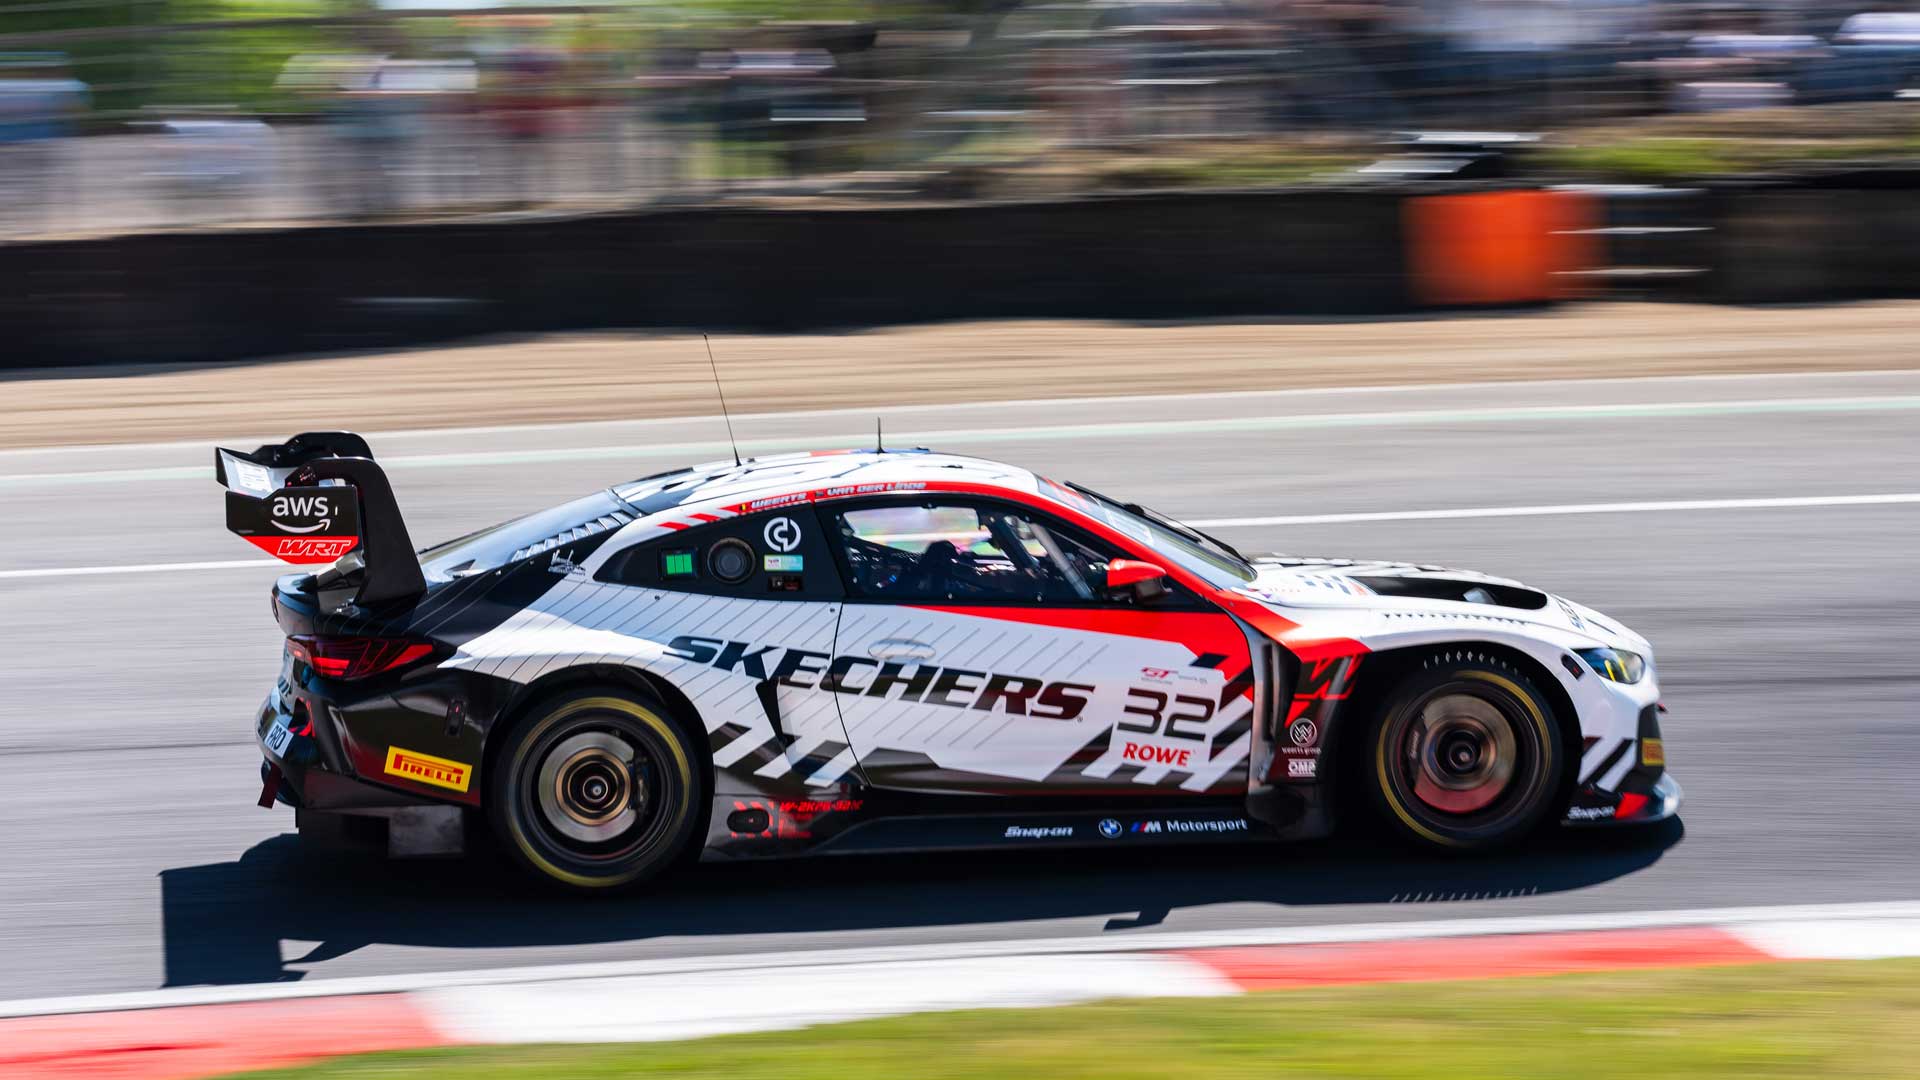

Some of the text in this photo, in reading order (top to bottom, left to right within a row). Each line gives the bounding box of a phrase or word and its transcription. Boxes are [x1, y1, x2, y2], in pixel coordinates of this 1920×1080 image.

[272, 496, 329, 517] aws
[277, 539, 352, 556] WRT
[663, 635, 1096, 721] SKECHERS
[1117, 687, 1216, 742] 32
[269, 725, 287, 751] PRO
[1122, 742, 1191, 768] ROWE
[1288, 759, 1317, 777] OMP
[393, 753, 464, 784] PIRELLI
[1166, 818, 1248, 833] Motorsport
